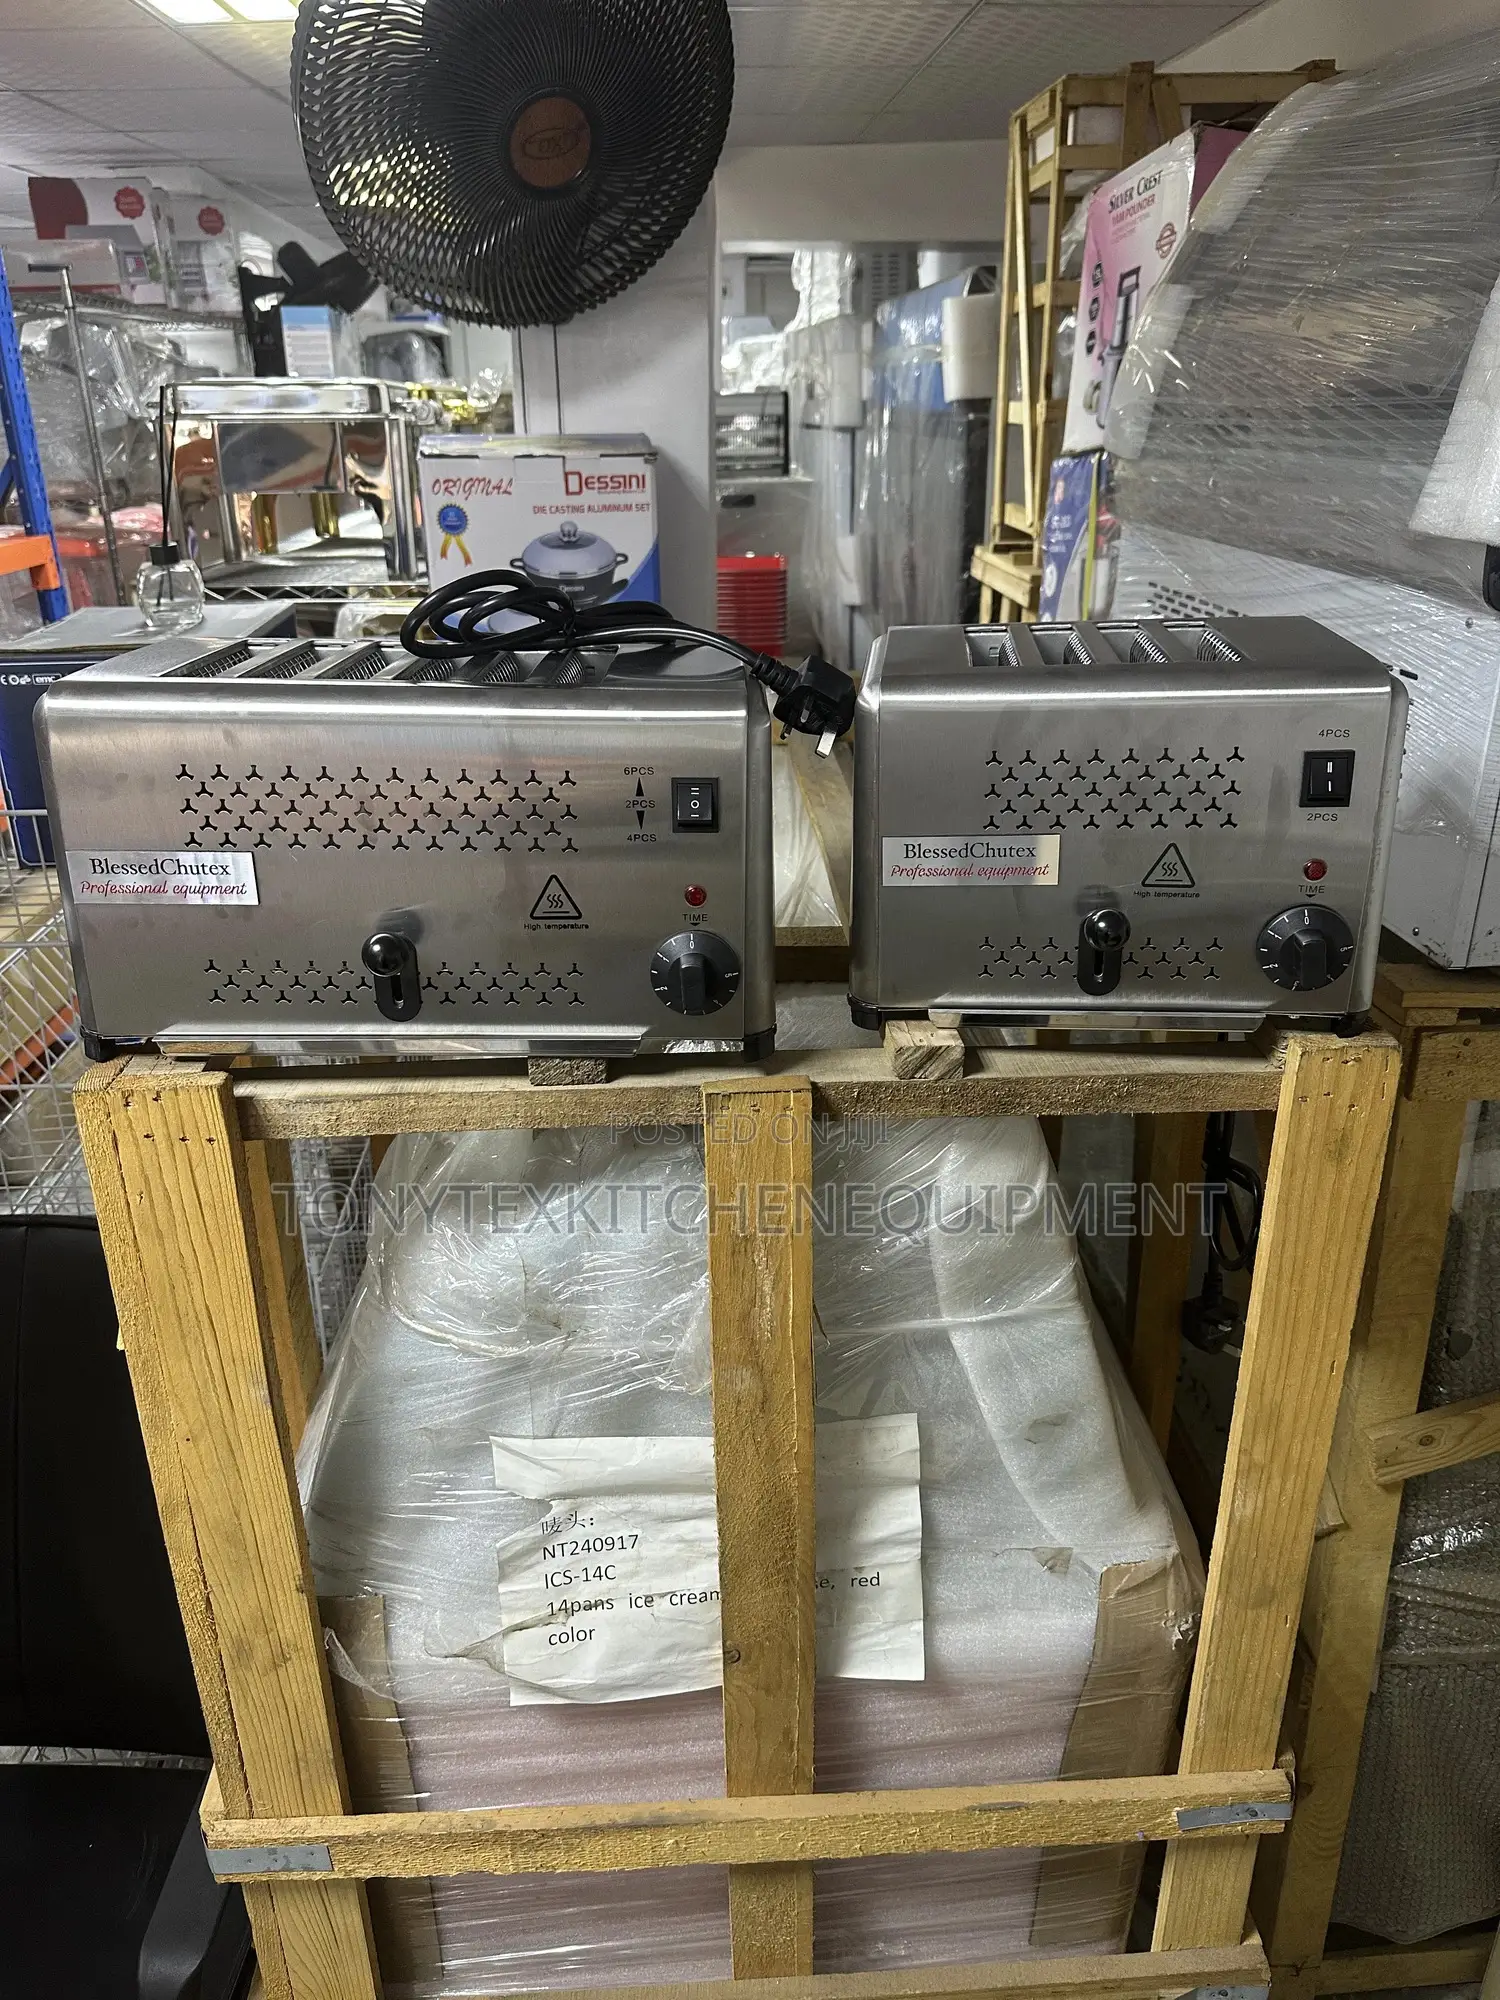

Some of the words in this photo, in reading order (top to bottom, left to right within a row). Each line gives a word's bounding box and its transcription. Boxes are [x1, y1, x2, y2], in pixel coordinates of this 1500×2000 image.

[1108, 186, 1134, 214] SILVER
[1137, 170, 1163, 195] CREST
[431, 477, 514, 500] ORIGINAL
[565, 471, 646, 496] DESSINI
[533, 505, 547, 515] DIE
[549, 504, 585, 514] CASTING
[635, 502, 651, 512] SET
[1318, 728, 1351, 738] 4PCS
[624, 767, 655, 776] 6PCS
[625, 799, 656, 809] 2PCS
[1307, 813, 1338, 822] 2PCS
[627, 833, 657, 843] 4PCS
[903, 842, 1037, 859] BlessedChutex
[89, 858, 231, 876] BlessedChutex
[891, 864, 973, 880] Professional
[977, 863, 1049, 880] equipment
[81, 880, 168, 897] Professional
[173, 882, 247, 899] equipment
[1154, 890, 1200, 898] temperature
[1298, 884, 1325, 894] TIME
[683, 913, 708, 922] TIME
[523, 923, 541, 931] High
[544, 923, 589, 931] temperature
[543, 1534, 639, 1560] NT240917
[544, 1564, 617, 1589] ICS-14C
[547, 1597, 614, 1617] 14pans
[629, 1593, 654, 1609] ice
[851, 1572, 880, 1588] red
[548, 1626, 596, 1646] color
